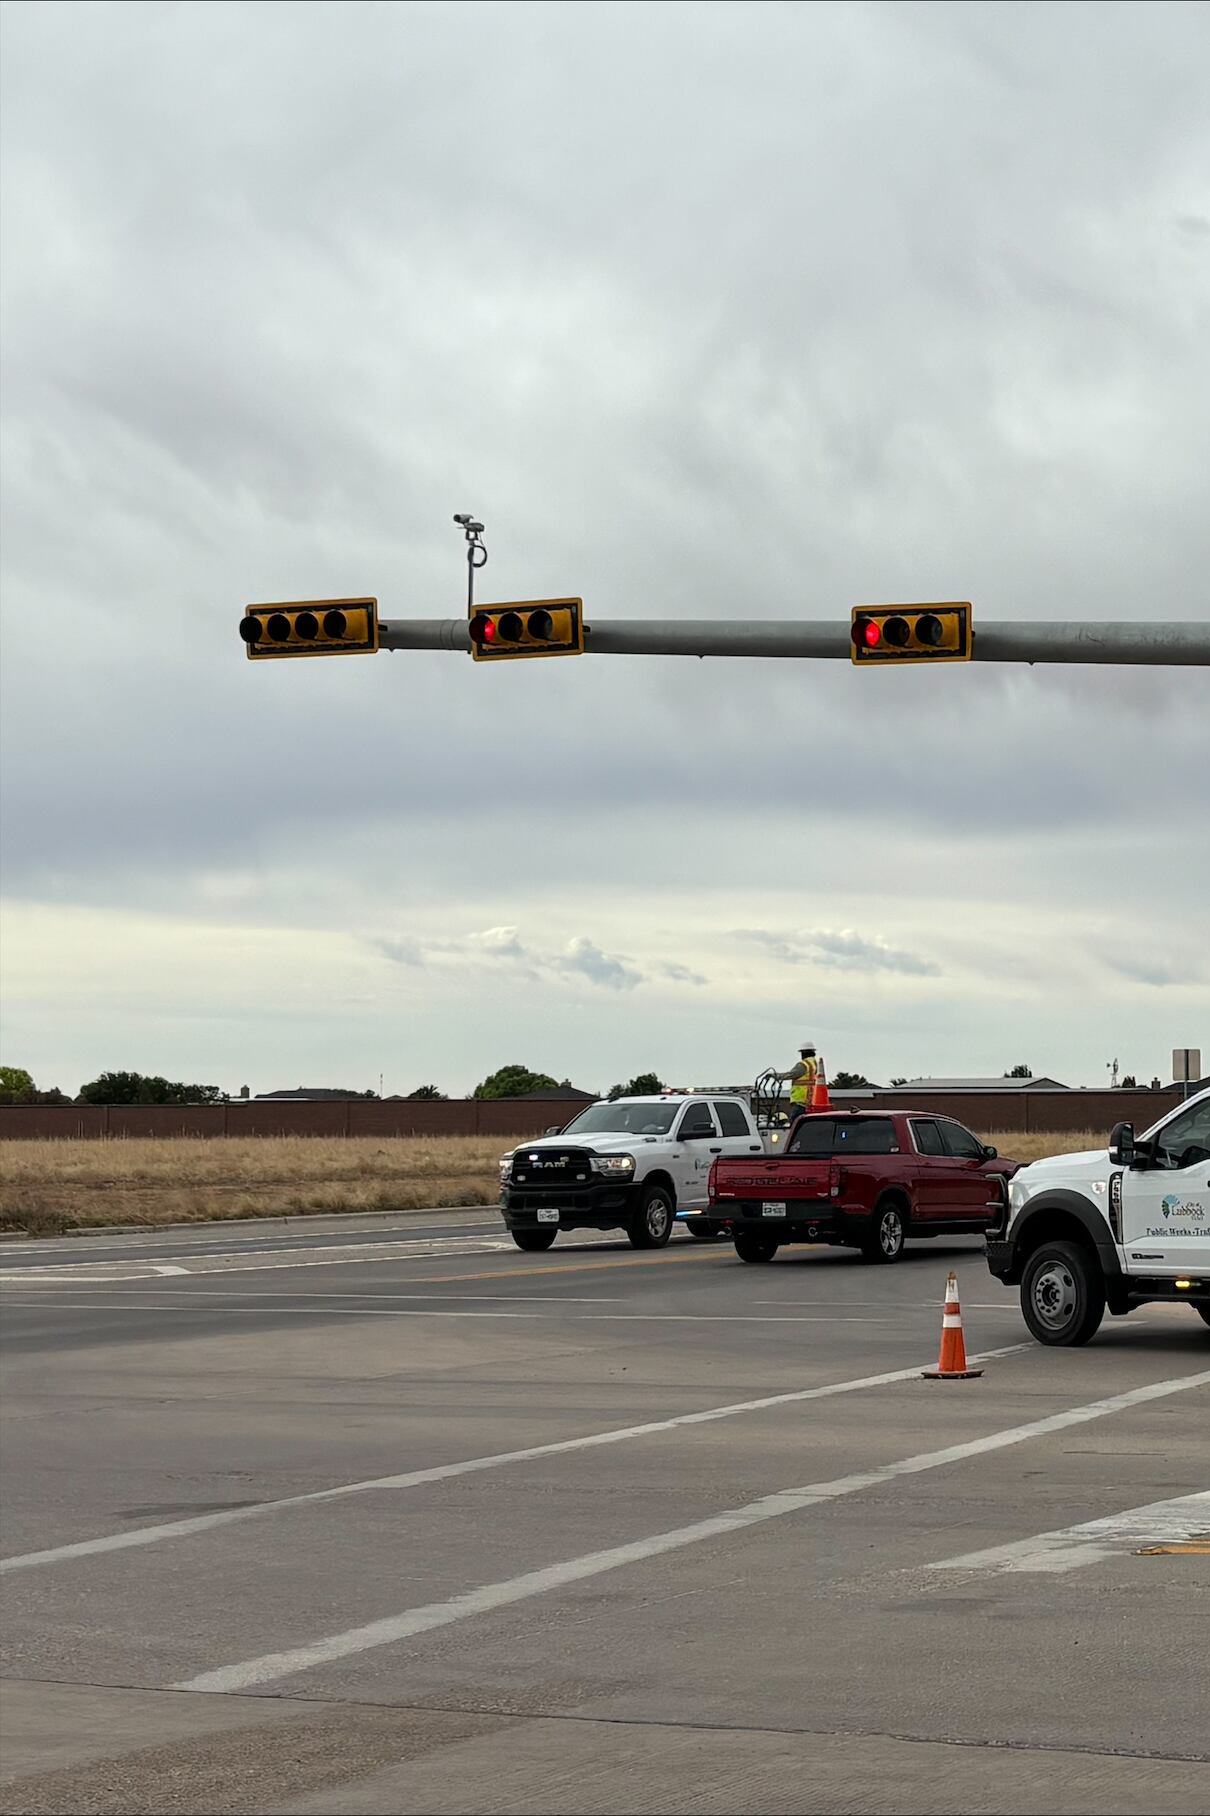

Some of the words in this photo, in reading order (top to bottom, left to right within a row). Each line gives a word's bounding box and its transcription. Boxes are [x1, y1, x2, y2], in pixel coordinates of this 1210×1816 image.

[532, 1161, 566, 1169] RAM
[1171, 1203, 1205, 1216] Lubbock
[1146, 1227, 1168, 1236] Public
